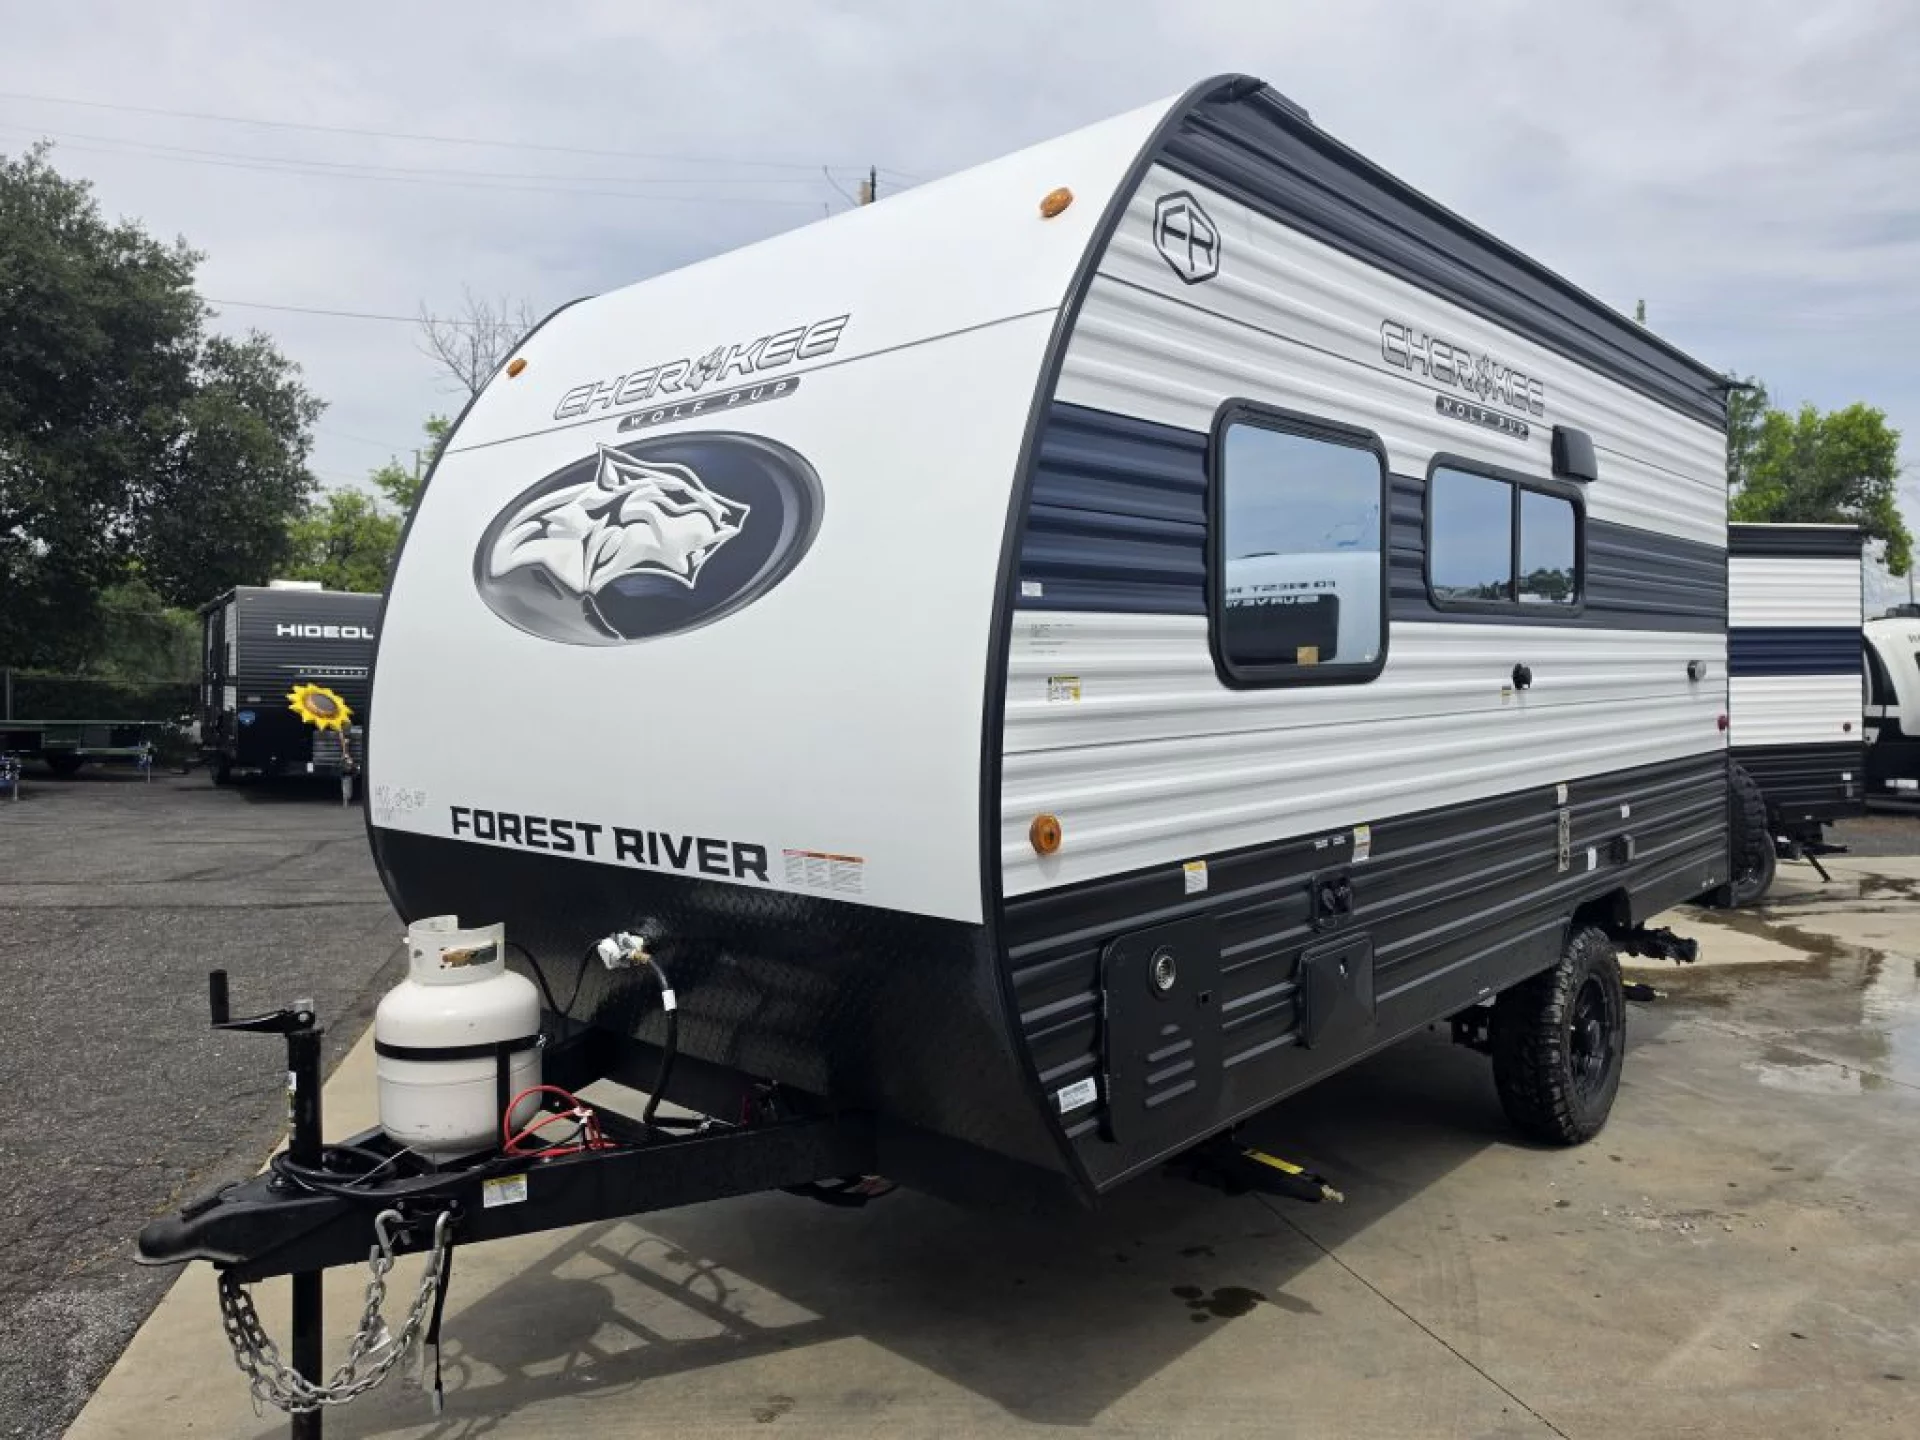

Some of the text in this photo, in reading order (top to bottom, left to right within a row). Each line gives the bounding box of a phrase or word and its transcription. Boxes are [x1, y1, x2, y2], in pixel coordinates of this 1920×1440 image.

[552, 313, 851, 420] CHEROKEE
[630, 381, 787, 427] WOLF PUP
[1379, 317, 1545, 418] CHEROKEE
[1443, 399, 1525, 436] WOLF PUP
[450, 806, 603, 856] FOREST
[612, 826, 769, 882] RIVER
